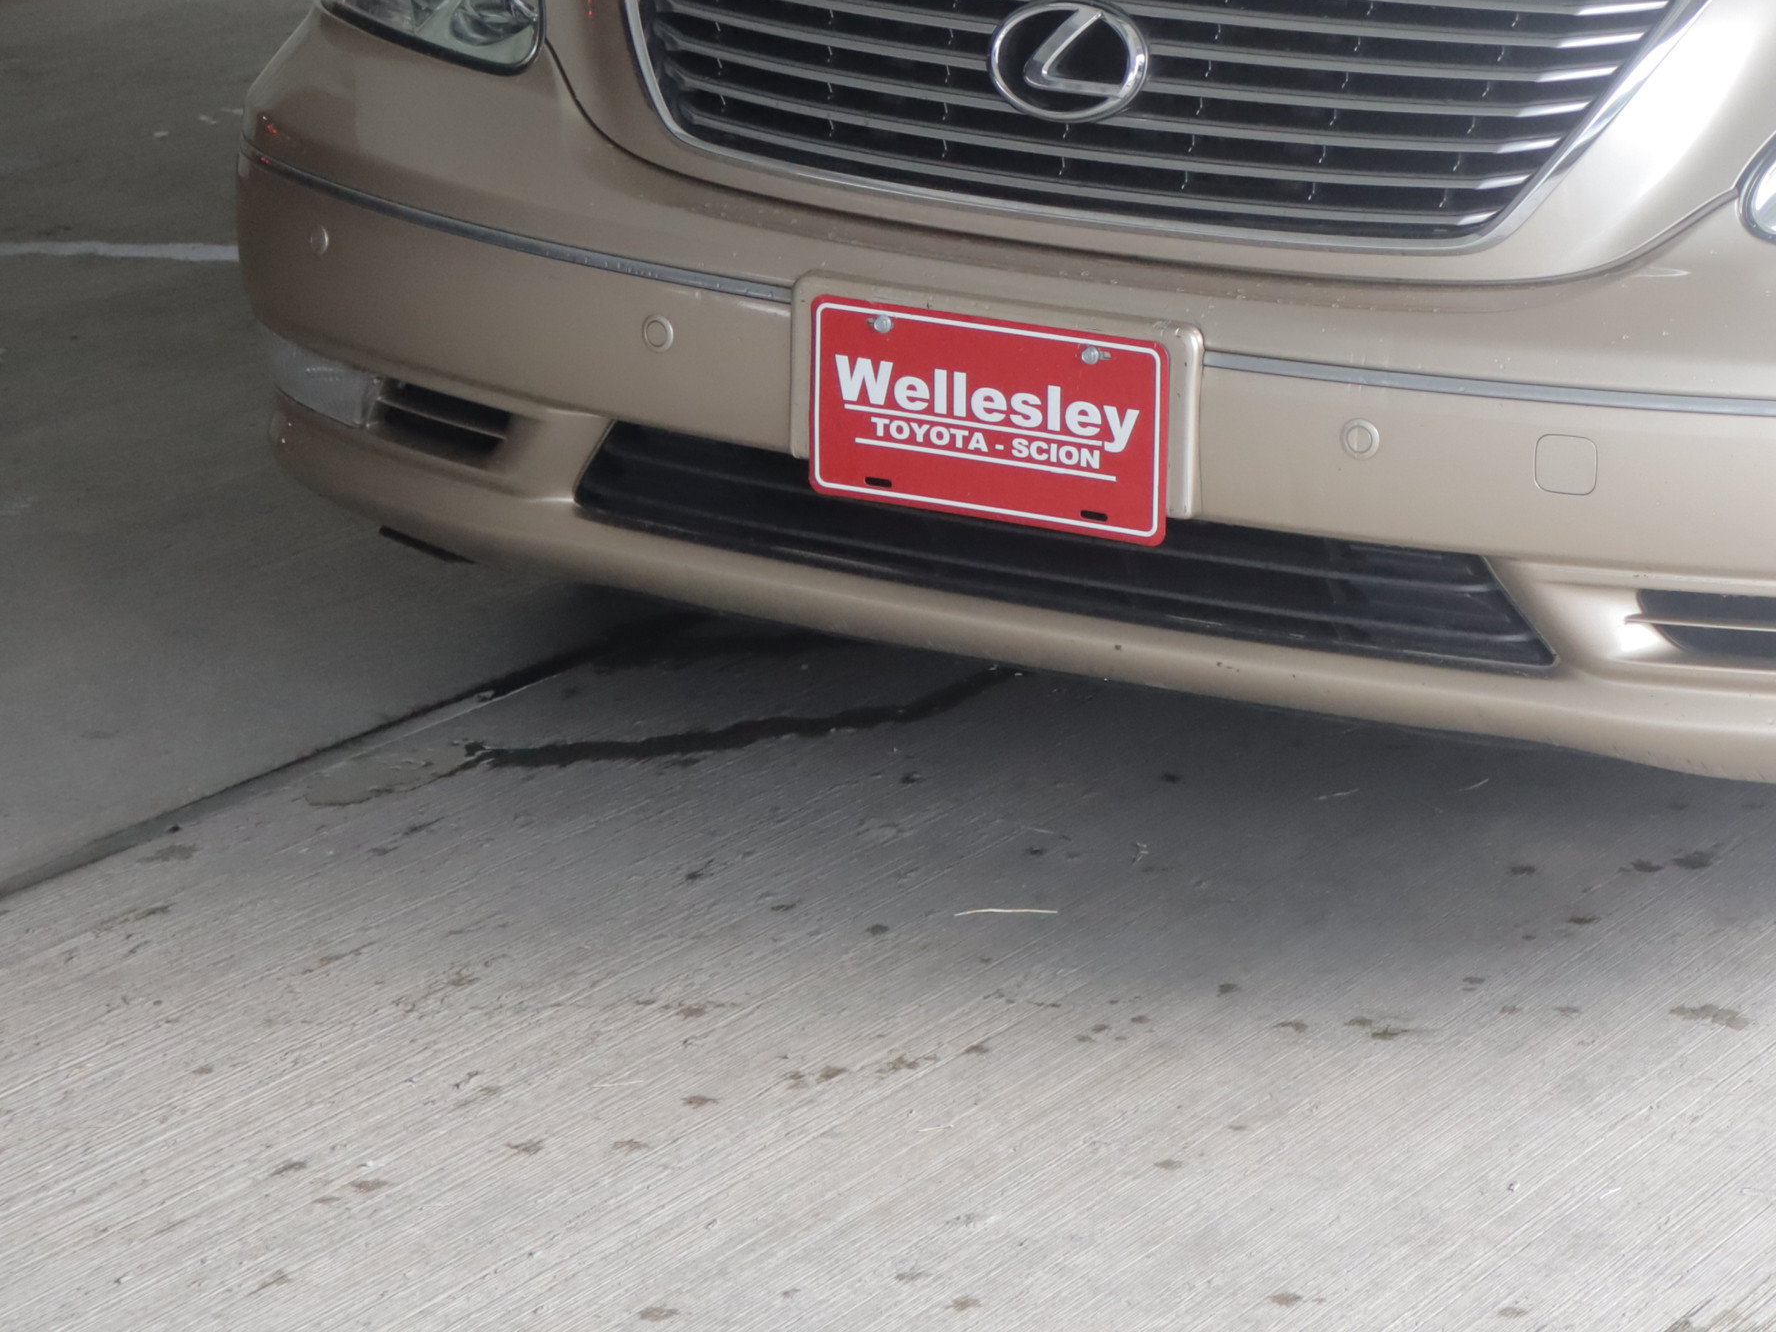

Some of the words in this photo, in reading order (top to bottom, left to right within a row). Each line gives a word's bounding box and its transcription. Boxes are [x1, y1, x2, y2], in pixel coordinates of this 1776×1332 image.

[835, 354, 1140, 454] Wellesley
[871, 417, 989, 453] TOYOTA
[1011, 438, 1101, 470] SCION
